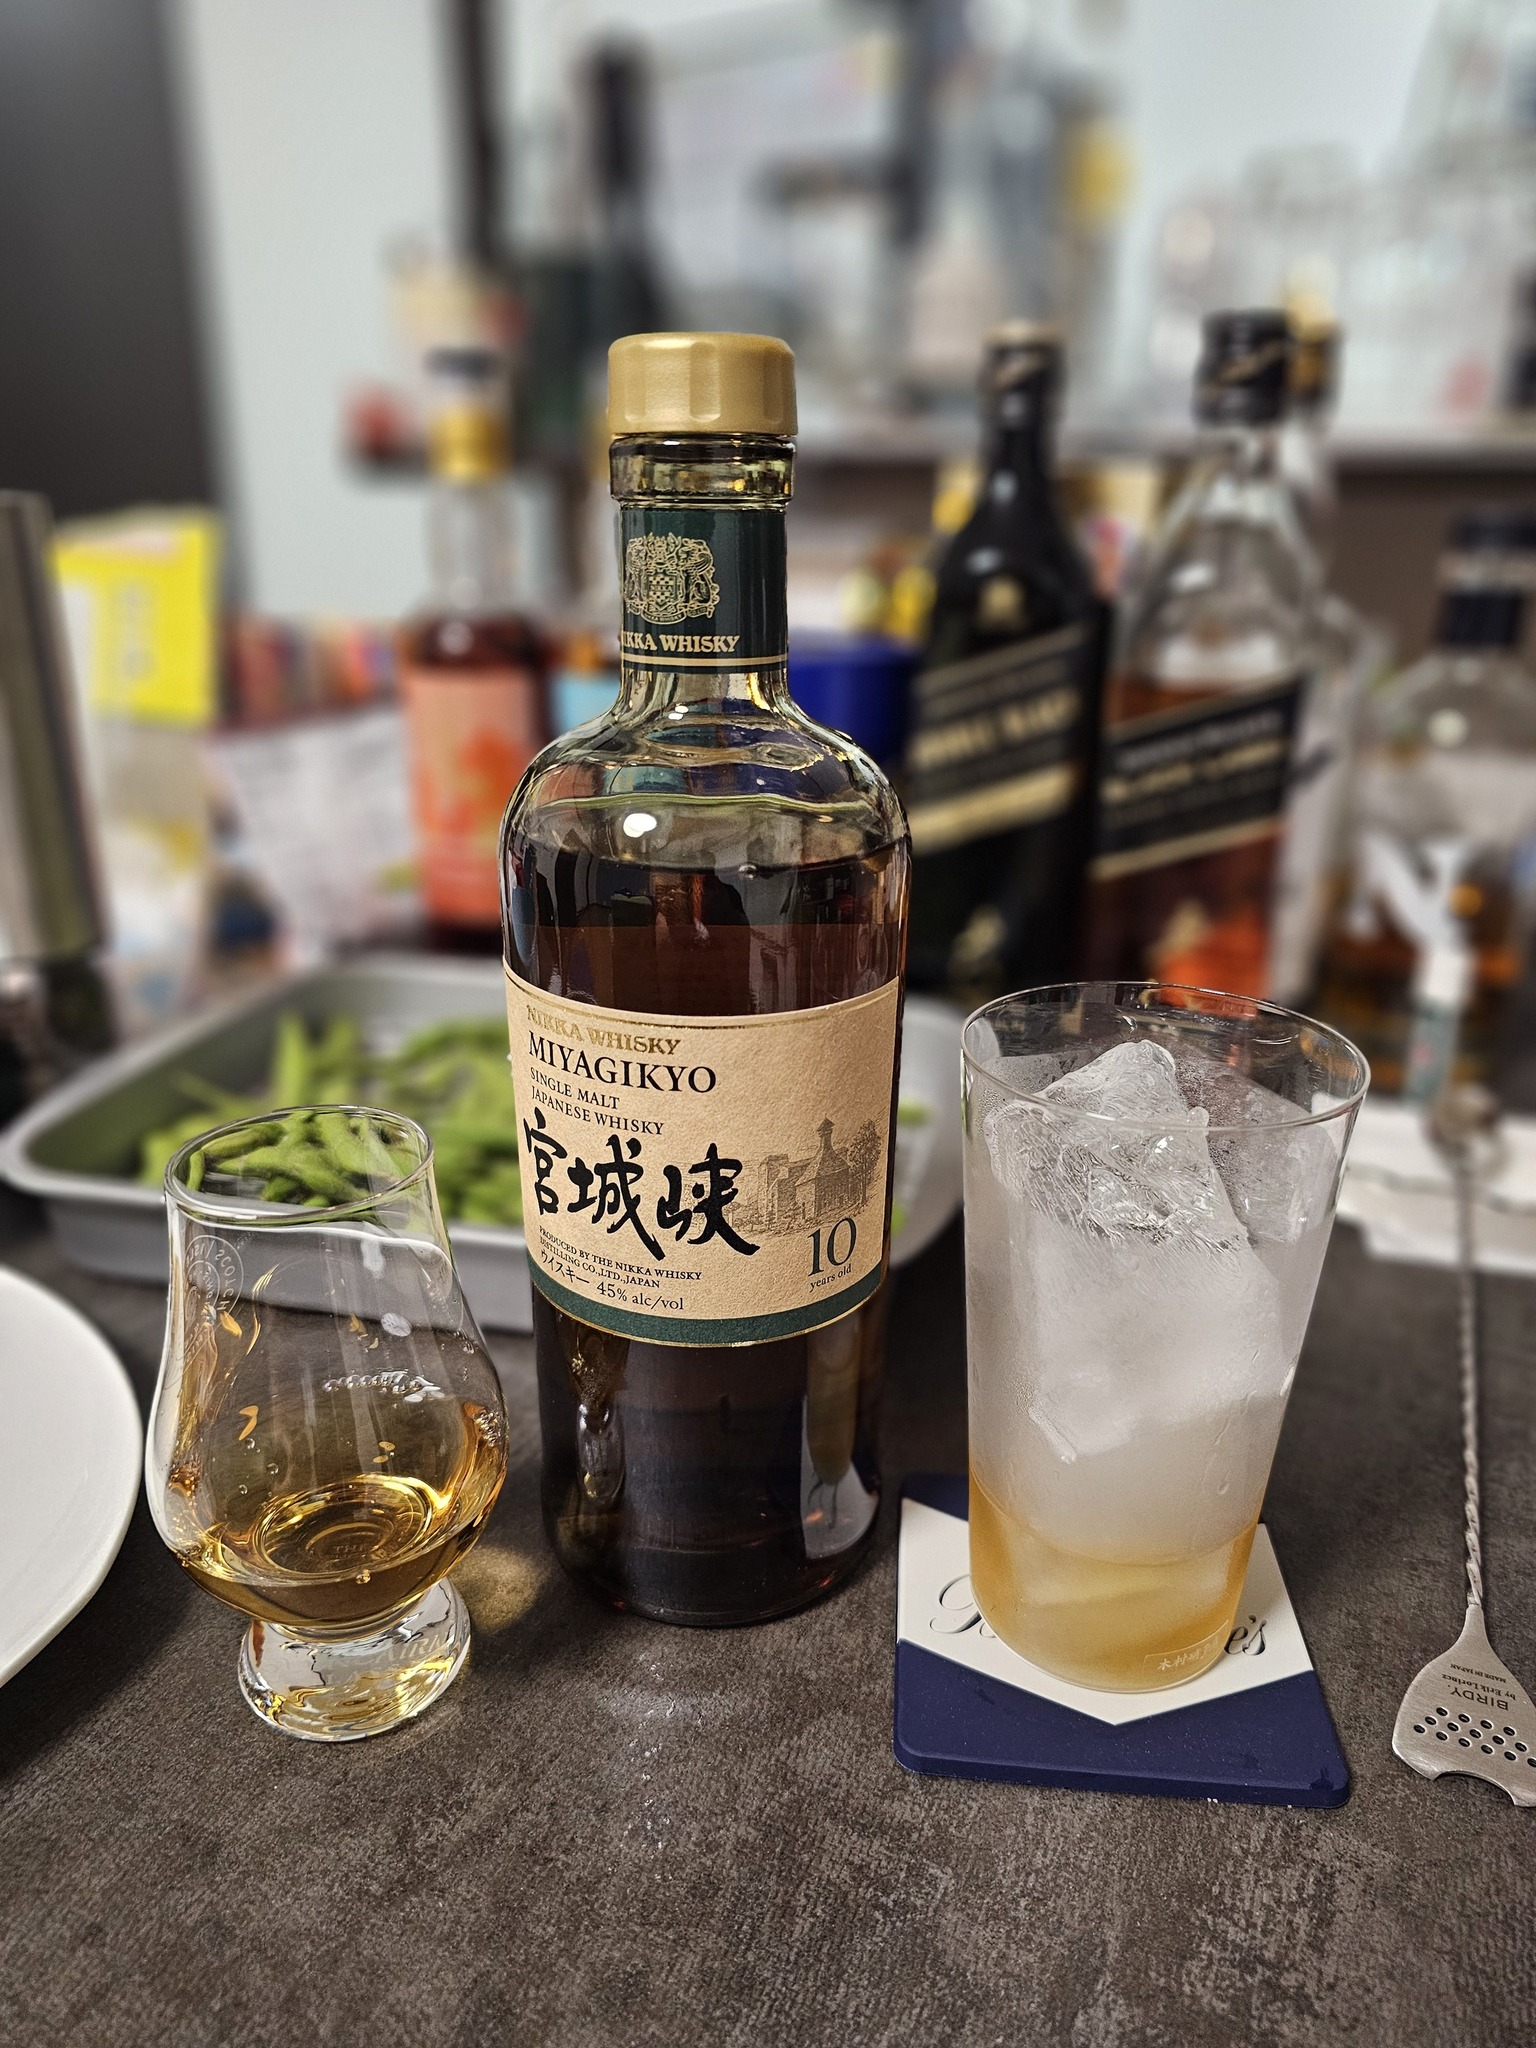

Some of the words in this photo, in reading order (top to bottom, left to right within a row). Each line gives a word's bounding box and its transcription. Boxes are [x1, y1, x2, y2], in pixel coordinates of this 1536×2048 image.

[659, 634, 741, 653] WHISKY
[526, 1005, 584, 1042] NIKKA
[587, 1027, 681, 1055] WHISKY
[529, 1030, 716, 1093] MIYAGIKYO
[530, 1067, 572, 1098] SINGLE
[577, 1088, 620, 1110] MALT
[531, 1085, 591, 1122] JAPANESE
[594, 1111, 664, 1135] WHISKY
[523, 1107, 760, 1261] 宮城峡
[539, 1236, 581, 1268] DISTILLING
[539, 1225, 577, 1255] PRODUCED
[579, 1250, 591, 1260] BY
[591, 1254, 613, 1267] THE
[615, 1262, 652, 1276] NIKKA
[654, 1269, 702, 1280] WHISKY
[807, 1217, 857, 1277] 10
[809, 1273, 836, 1293] years
[837, 1263, 852, 1278] old
[596, 1281, 628, 1302] 45%
[632, 1292, 684, 1310] alc/vol
[1441, 1673, 1479, 1690] Lorincz
[1450, 1663, 1474, 1675] JAPAN
[1474, 1670, 1484, 1678] IN
[1484, 1673, 1507, 1684] MADE
[1480, 1684, 1502, 1697] Erik
[1504, 1691, 1516, 1701] by
